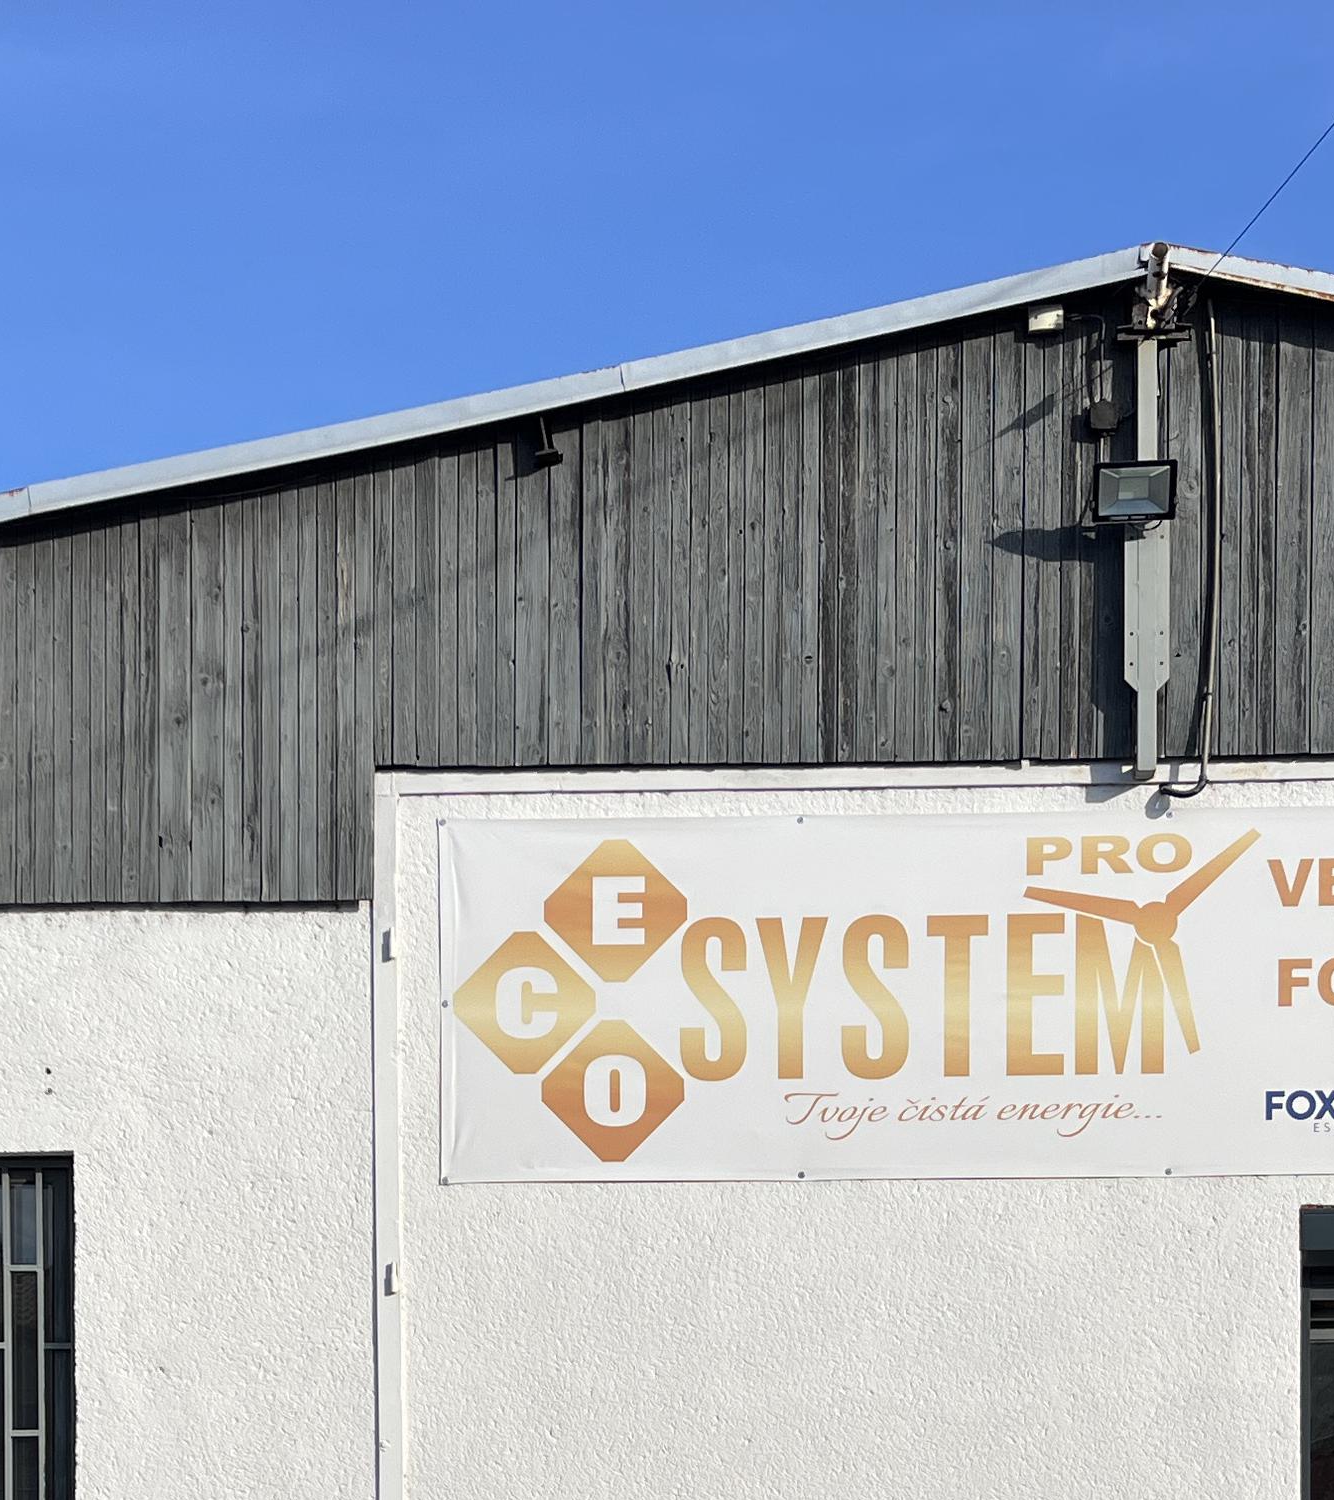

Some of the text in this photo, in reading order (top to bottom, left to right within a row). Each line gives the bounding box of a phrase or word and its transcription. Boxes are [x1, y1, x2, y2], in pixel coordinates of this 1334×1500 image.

[1025, 833, 1193, 876] PRO
[679, 913, 1166, 1082] SYSTEM
[784, 1092, 1163, 1140] Tvoje čistá energie...
